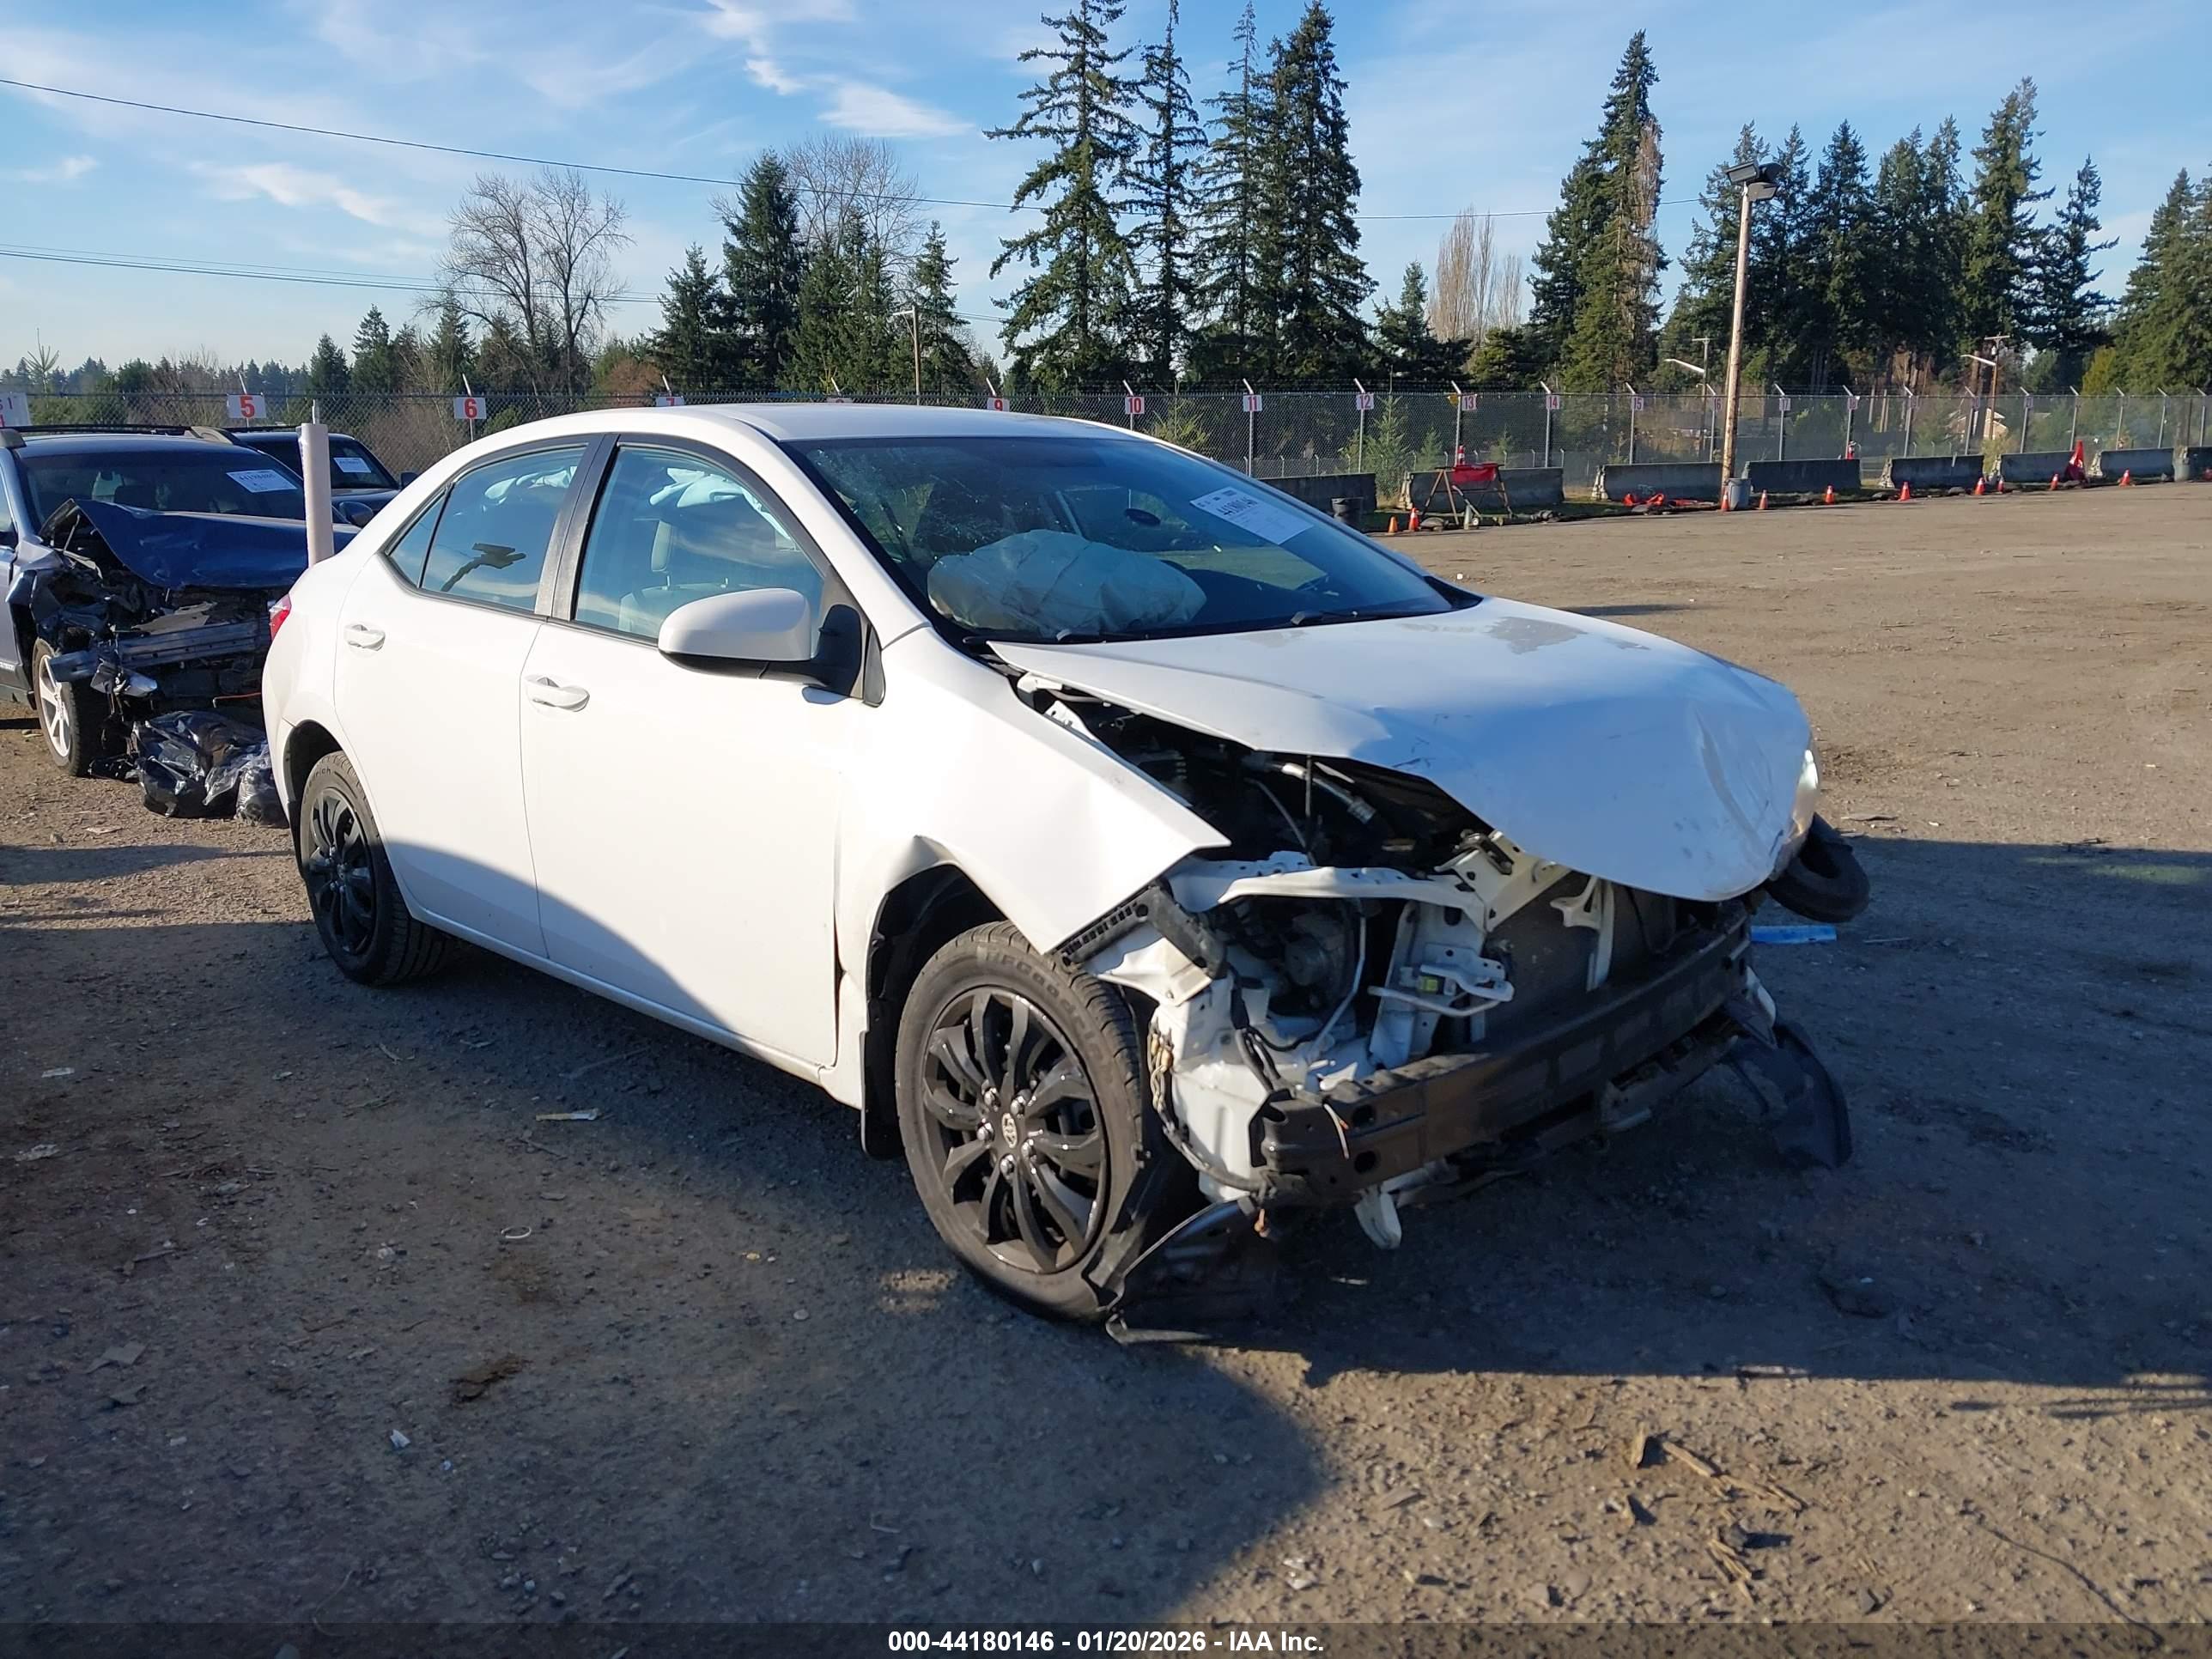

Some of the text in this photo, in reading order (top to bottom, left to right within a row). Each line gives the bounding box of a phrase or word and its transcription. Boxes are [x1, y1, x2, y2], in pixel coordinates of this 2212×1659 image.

[240, 395, 255, 418] 5
[465, 398, 477, 418] 6
[666, 398, 675, 406] 7
[994, 399, 1003, 411] 9
[1128, 398, 1141, 413] 10
[1249, 396, 1258, 411] 11
[1360, 395, 1371, 409] 12
[1464, 396, 1474, 410] 13
[1549, 397, 1559, 408] 14
[1633, 397, 1643, 410] 15
